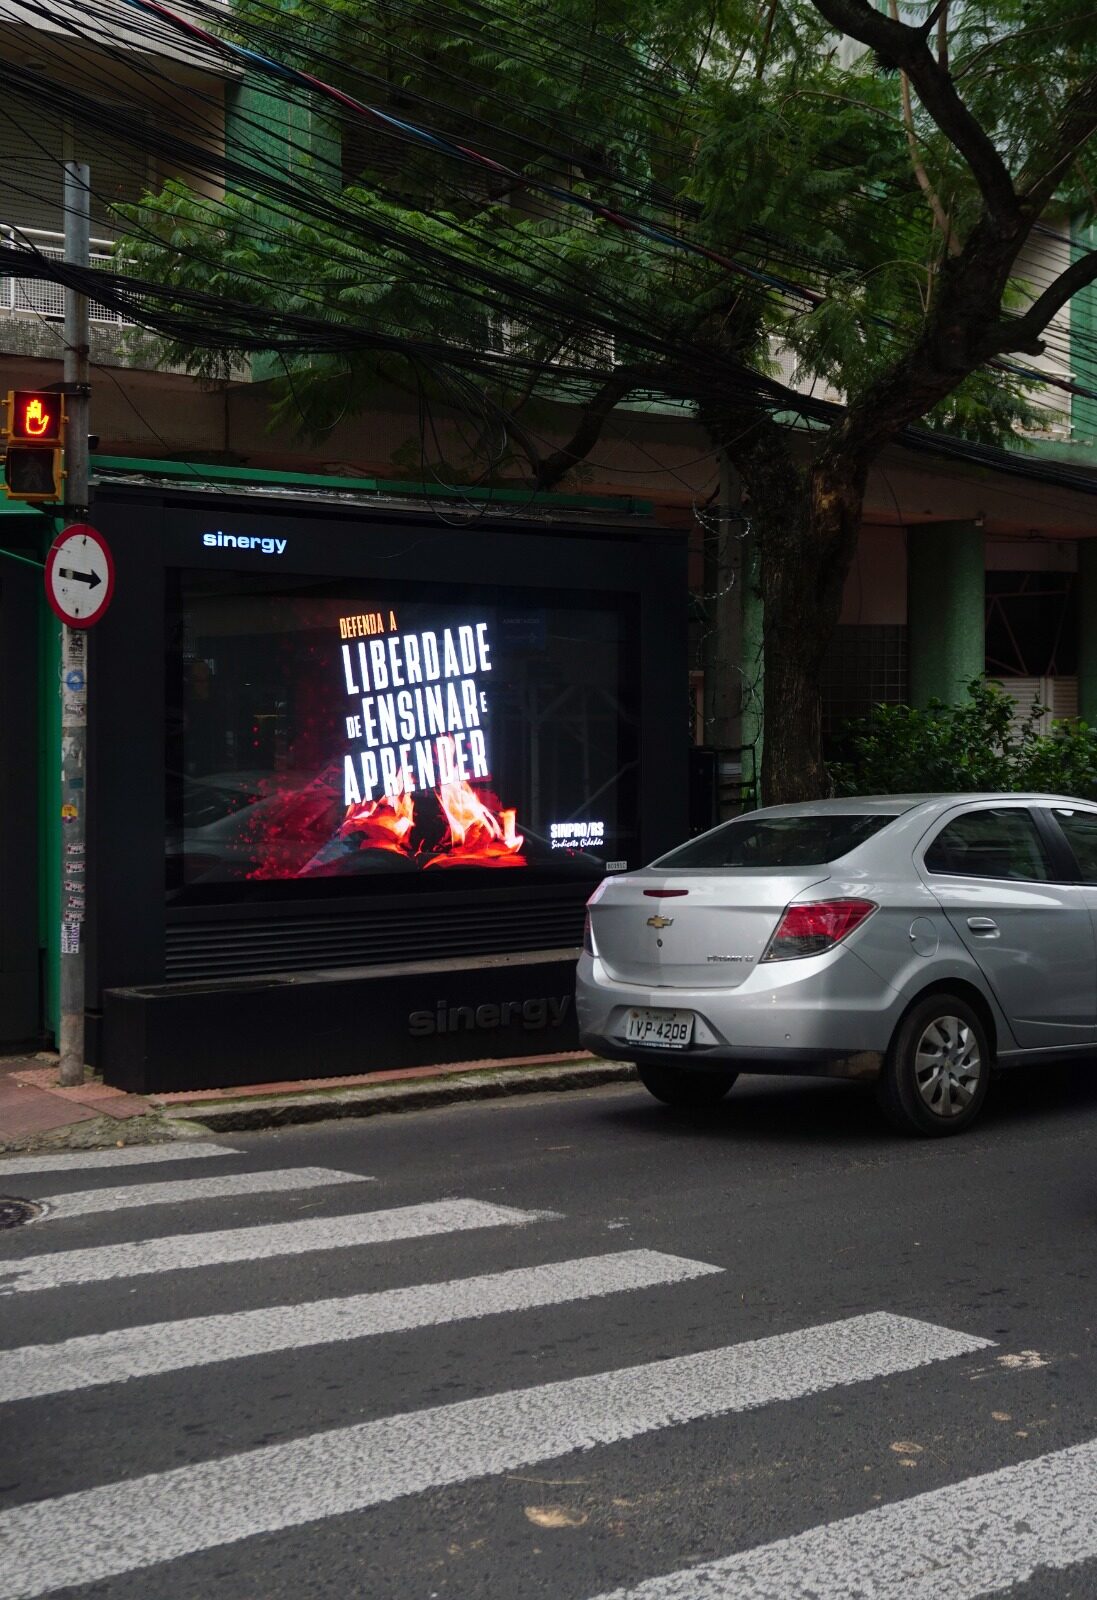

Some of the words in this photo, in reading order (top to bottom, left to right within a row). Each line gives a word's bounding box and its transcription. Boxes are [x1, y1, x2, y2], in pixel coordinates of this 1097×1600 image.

[203, 531, 287, 554] sinergy
[340, 613, 384, 638] DEFENDA
[389, 610, 398, 632] A
[341, 623, 492, 695] LIBERDADE
[346, 715, 362, 739] DE
[361, 678, 482, 748] ENSINAR
[480, 691, 488, 713] E
[344, 729, 489, 806] APRENDER
[550, 822, 604, 838] SINPRO/RS
[407, 995, 572, 1036] sinergy
